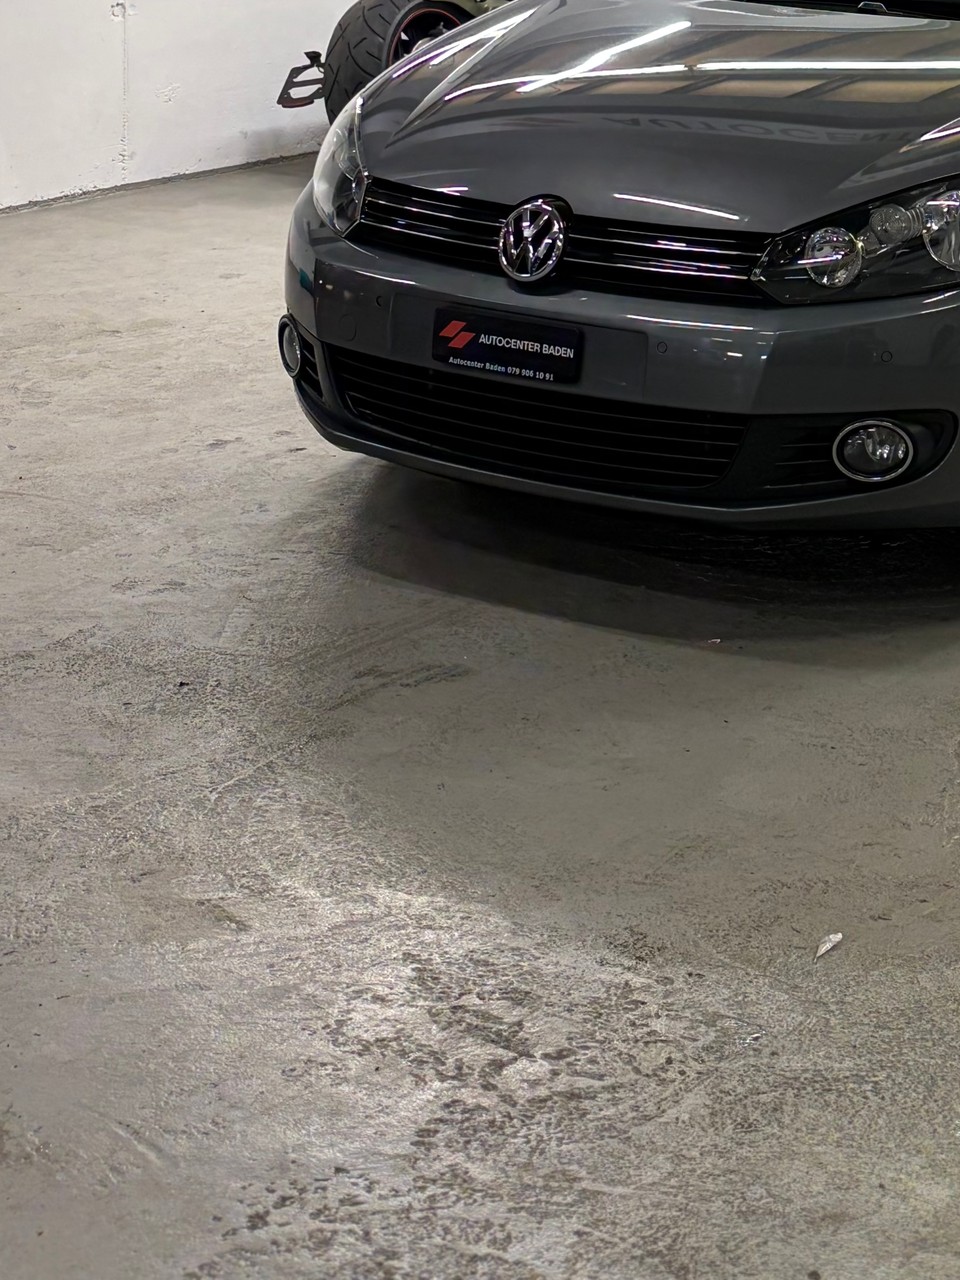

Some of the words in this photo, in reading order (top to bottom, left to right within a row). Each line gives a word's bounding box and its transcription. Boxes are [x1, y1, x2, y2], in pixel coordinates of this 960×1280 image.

[479, 333, 541, 353] AUTOCENTER
[542, 344, 574, 359] BADEN
[448, 356, 484, 369] Autocenter
[485, 362, 506, 372] Baden
[507, 366, 520, 375] 079
[535, 371, 544, 379] 10
[545, 373, 554, 381] 91
